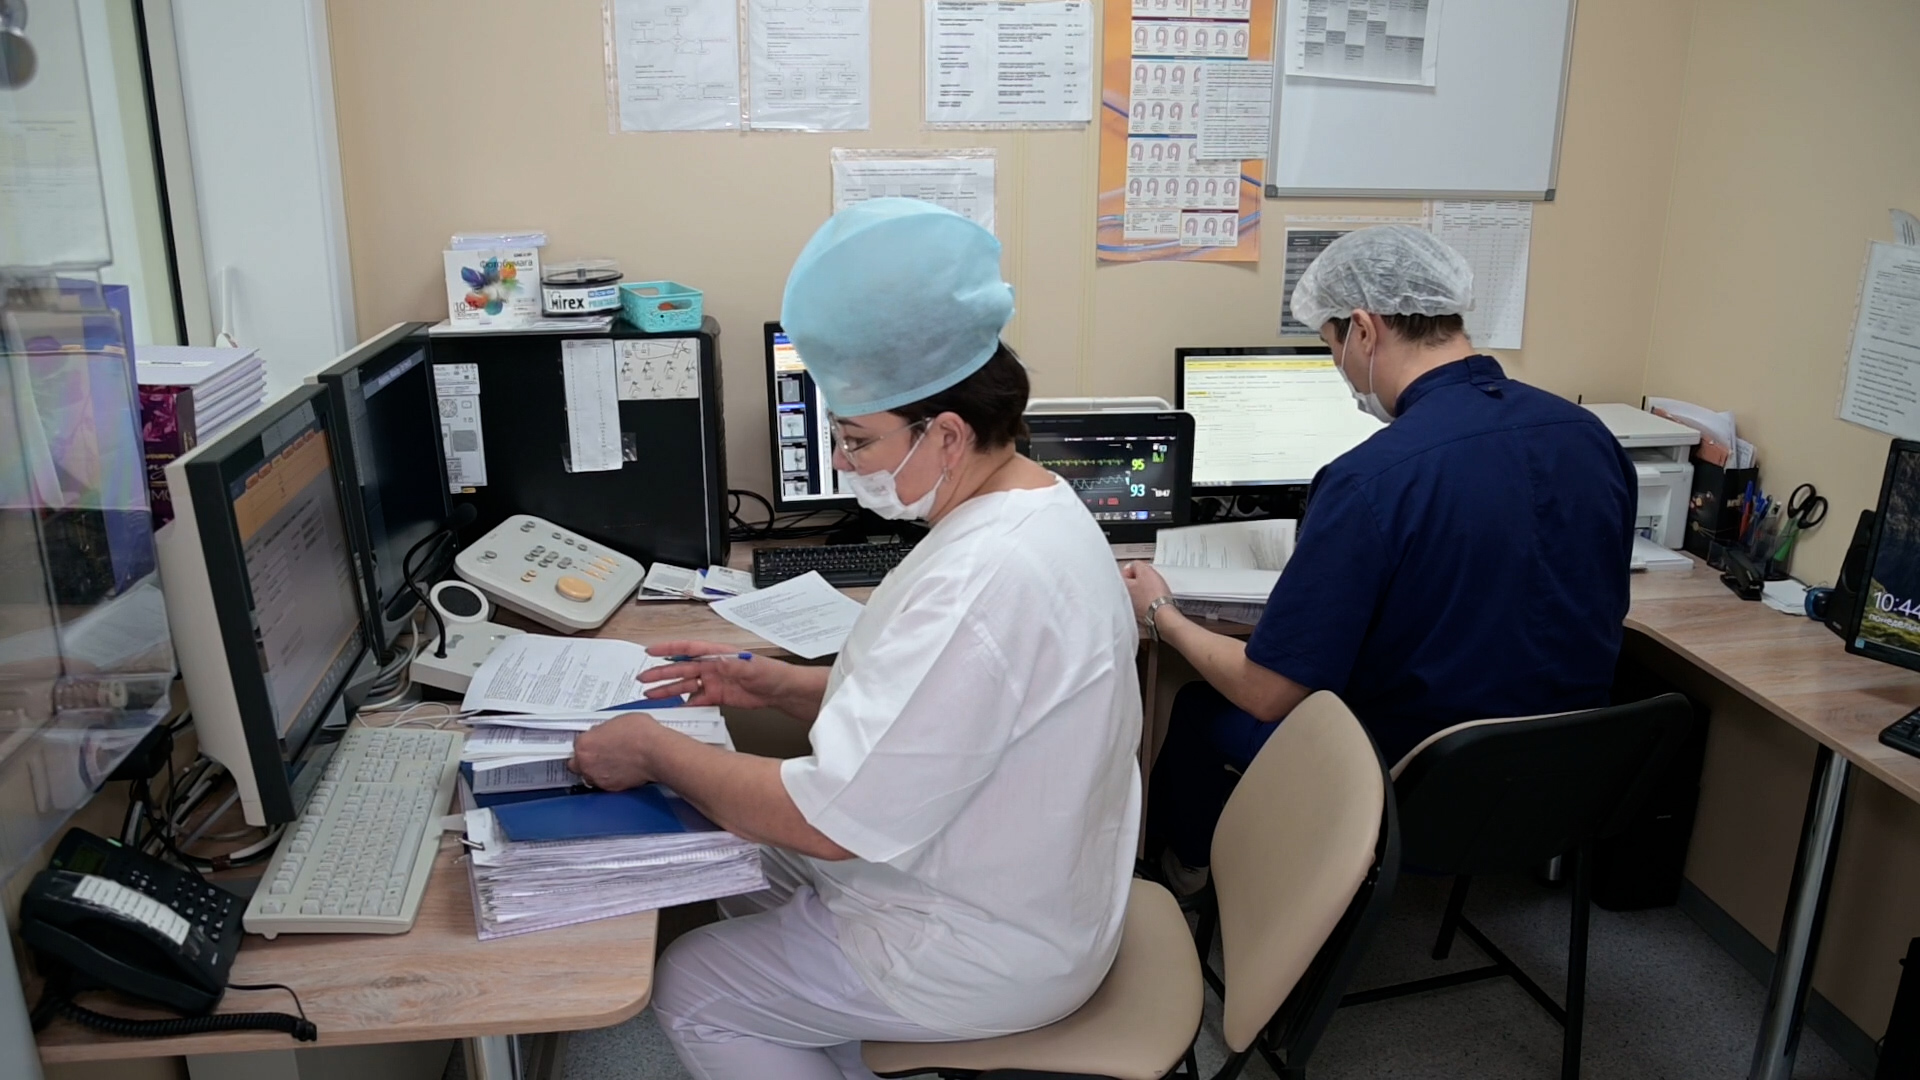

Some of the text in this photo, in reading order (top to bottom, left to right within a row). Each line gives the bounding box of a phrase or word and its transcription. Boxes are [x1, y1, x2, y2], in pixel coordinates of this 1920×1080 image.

[1131, 458, 1145, 471] 95
[1130, 483, 1145, 497] 93
[1873, 592, 1920, 620] 10:44
